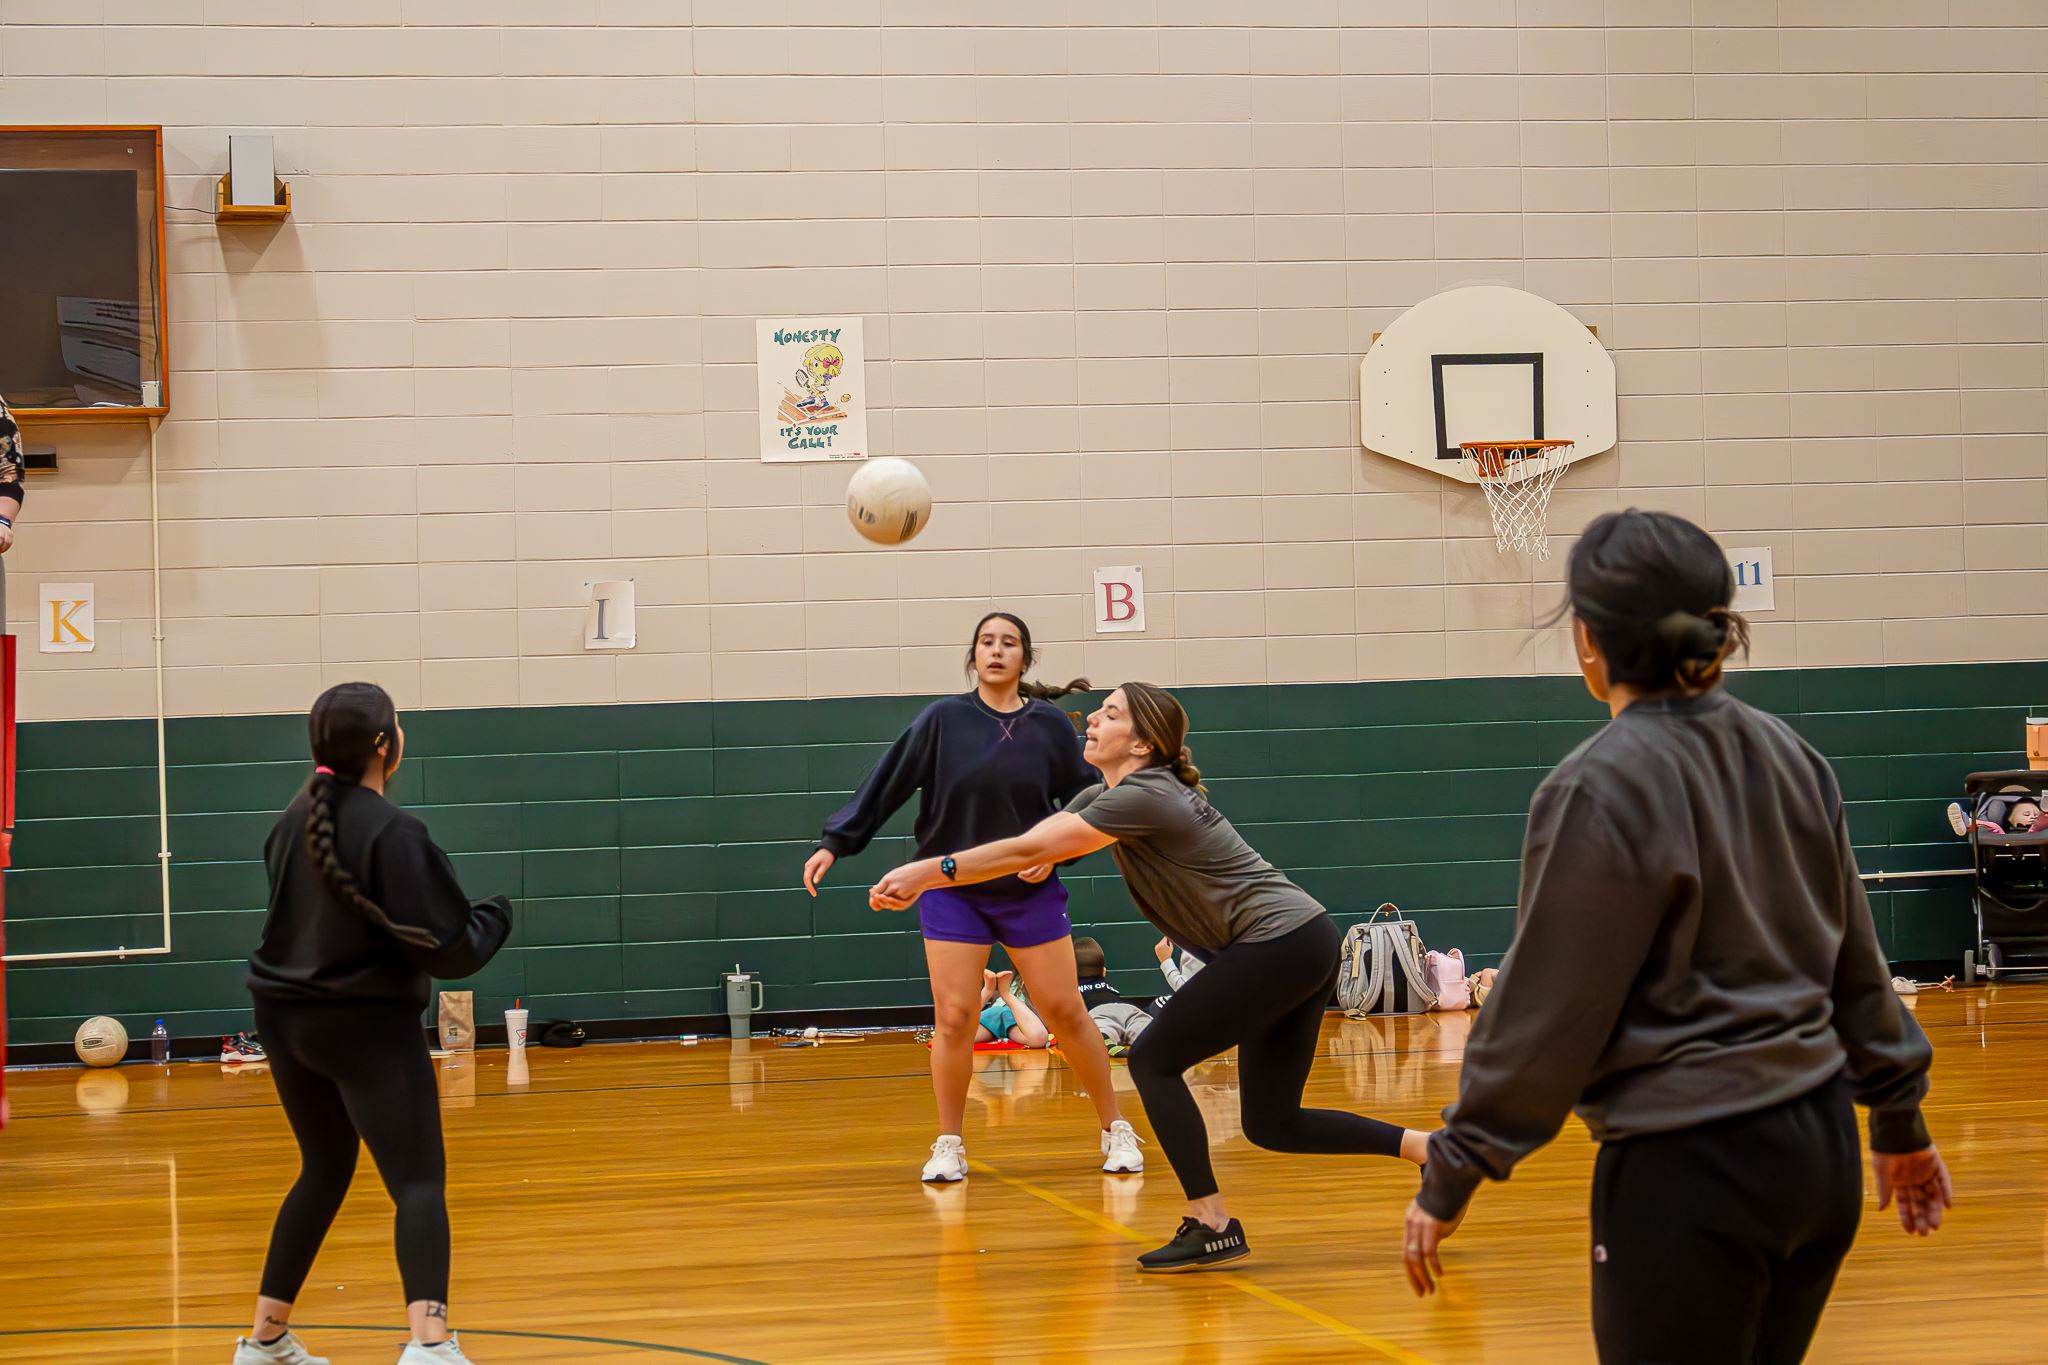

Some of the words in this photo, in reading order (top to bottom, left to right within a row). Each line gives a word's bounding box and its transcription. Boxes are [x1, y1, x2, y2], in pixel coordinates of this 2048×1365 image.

[774, 328, 841, 345] HONESTY
[780, 423, 801, 437] IT'S
[806, 424, 838, 436] YOUR
[788, 436, 832, 449] CALL!
[1100, 582, 1136, 621] B
[48, 600, 94, 642] K
[592, 598, 609, 639] I
